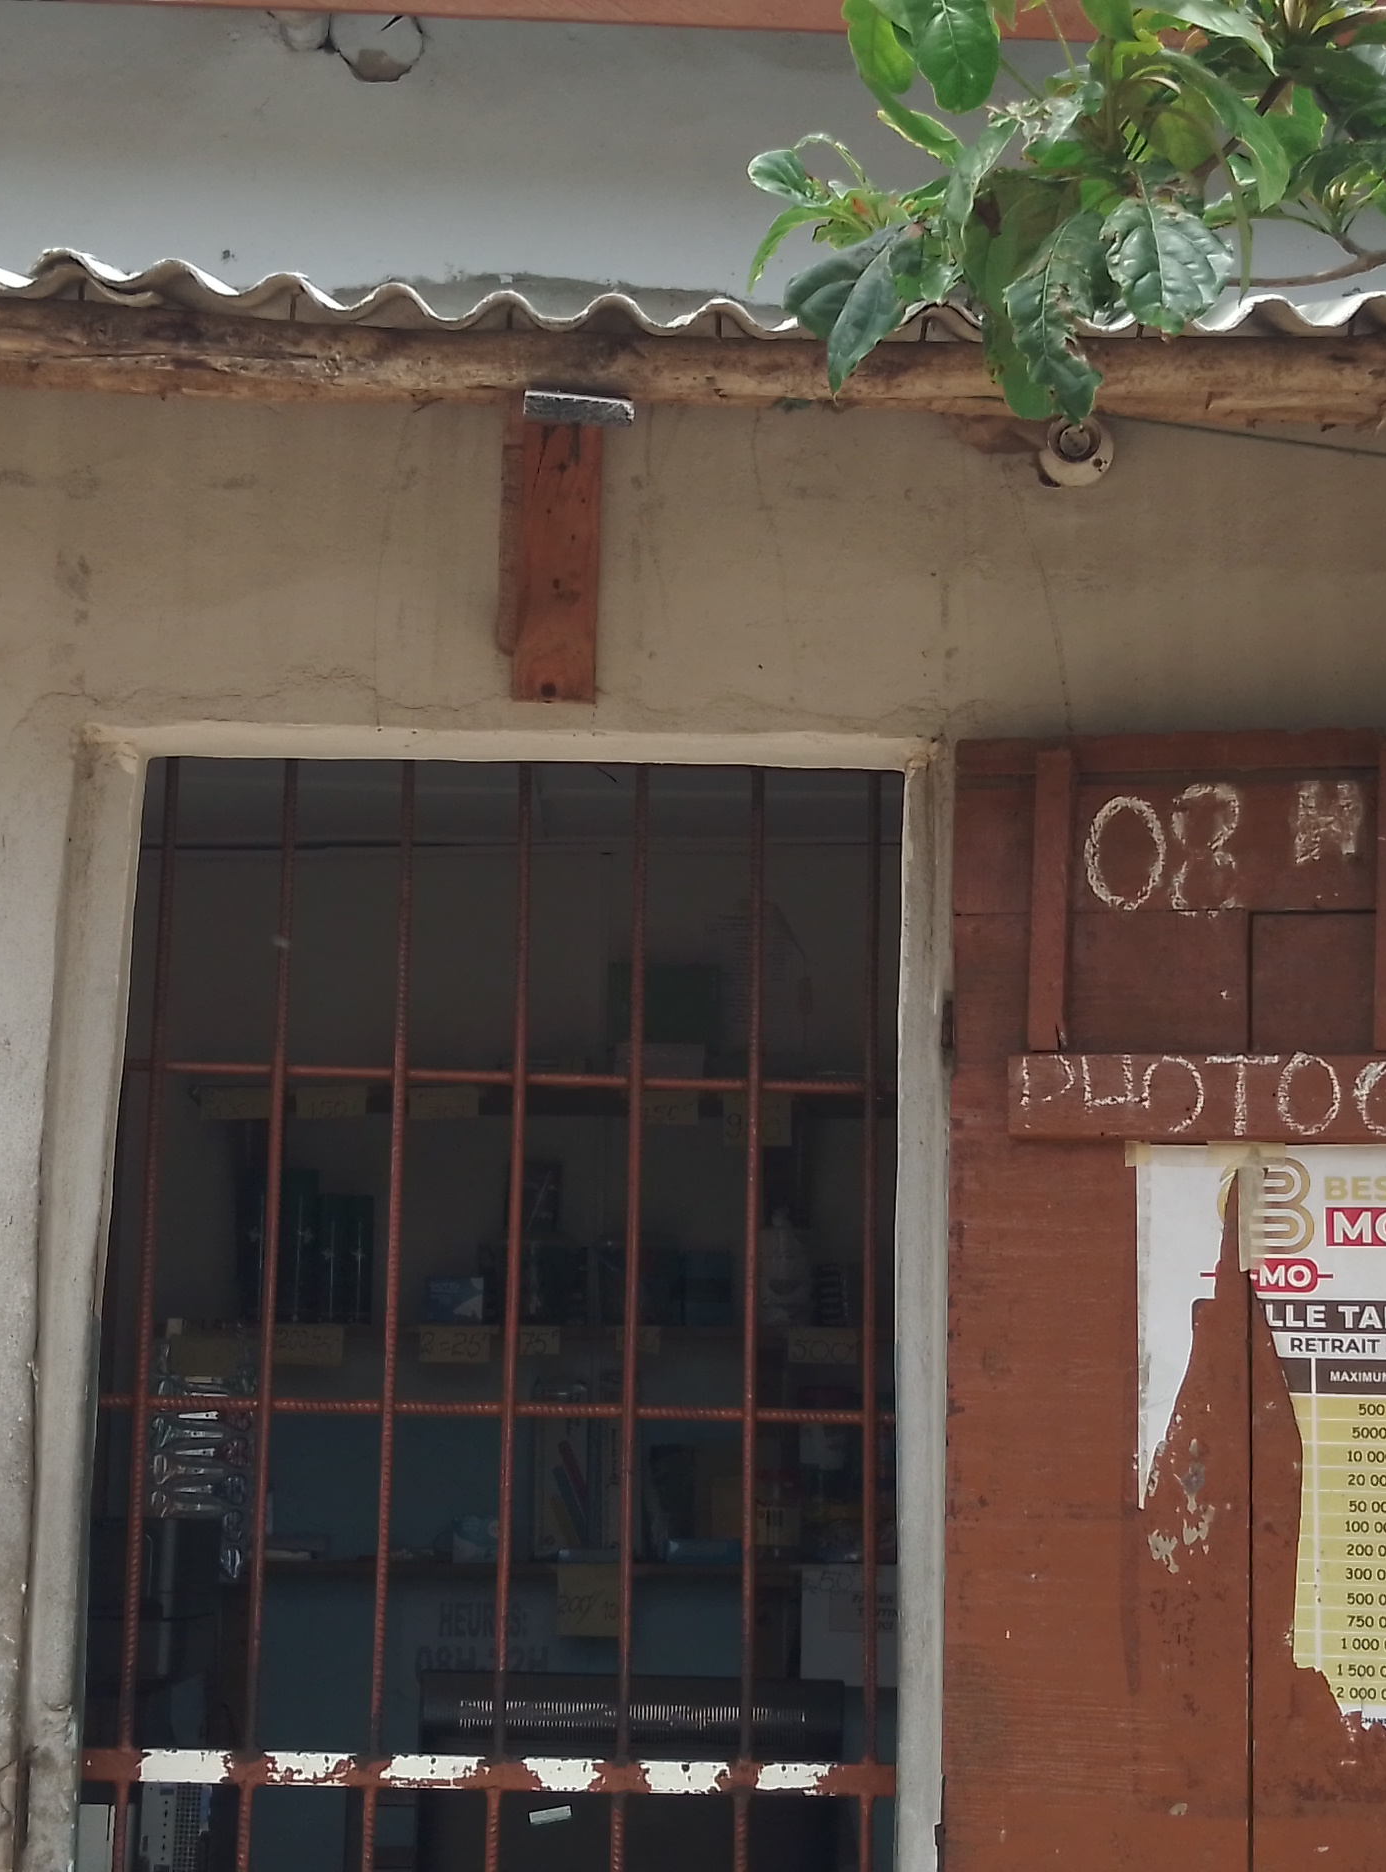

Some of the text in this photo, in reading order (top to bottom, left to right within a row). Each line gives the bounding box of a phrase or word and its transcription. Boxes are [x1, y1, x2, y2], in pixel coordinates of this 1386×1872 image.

[1290, 1337, 1380, 1354] RETRAIT
[1359, 1404, 1385, 1416] 500
[1352, 1427, 1386, 1439] 5000
[1347, 1451, 1362, 1463] 10
[1348, 1474, 1365, 1486] 20
[1349, 1501, 1366, 1513] 50
[1345, 1521, 1369, 1533] 100
[1346, 1544, 1373, 1557] 200
[1346, 1568, 1372, 1580] 300
[1347, 1593, 1374, 1605] 500
[439, 1602, 527, 1637] HEURS:
[1347, 1615, 1374, 1628] 750
[1341, 1638, 1346, 1649] 1
[1352, 1638, 1379, 1651] 000
[1338, 1665, 1343, 1676] 1
[1348, 1665, 1375, 1677] 500
[1337, 1687, 1344, 1699] 2
[1349, 1687, 1376, 1700] 000
